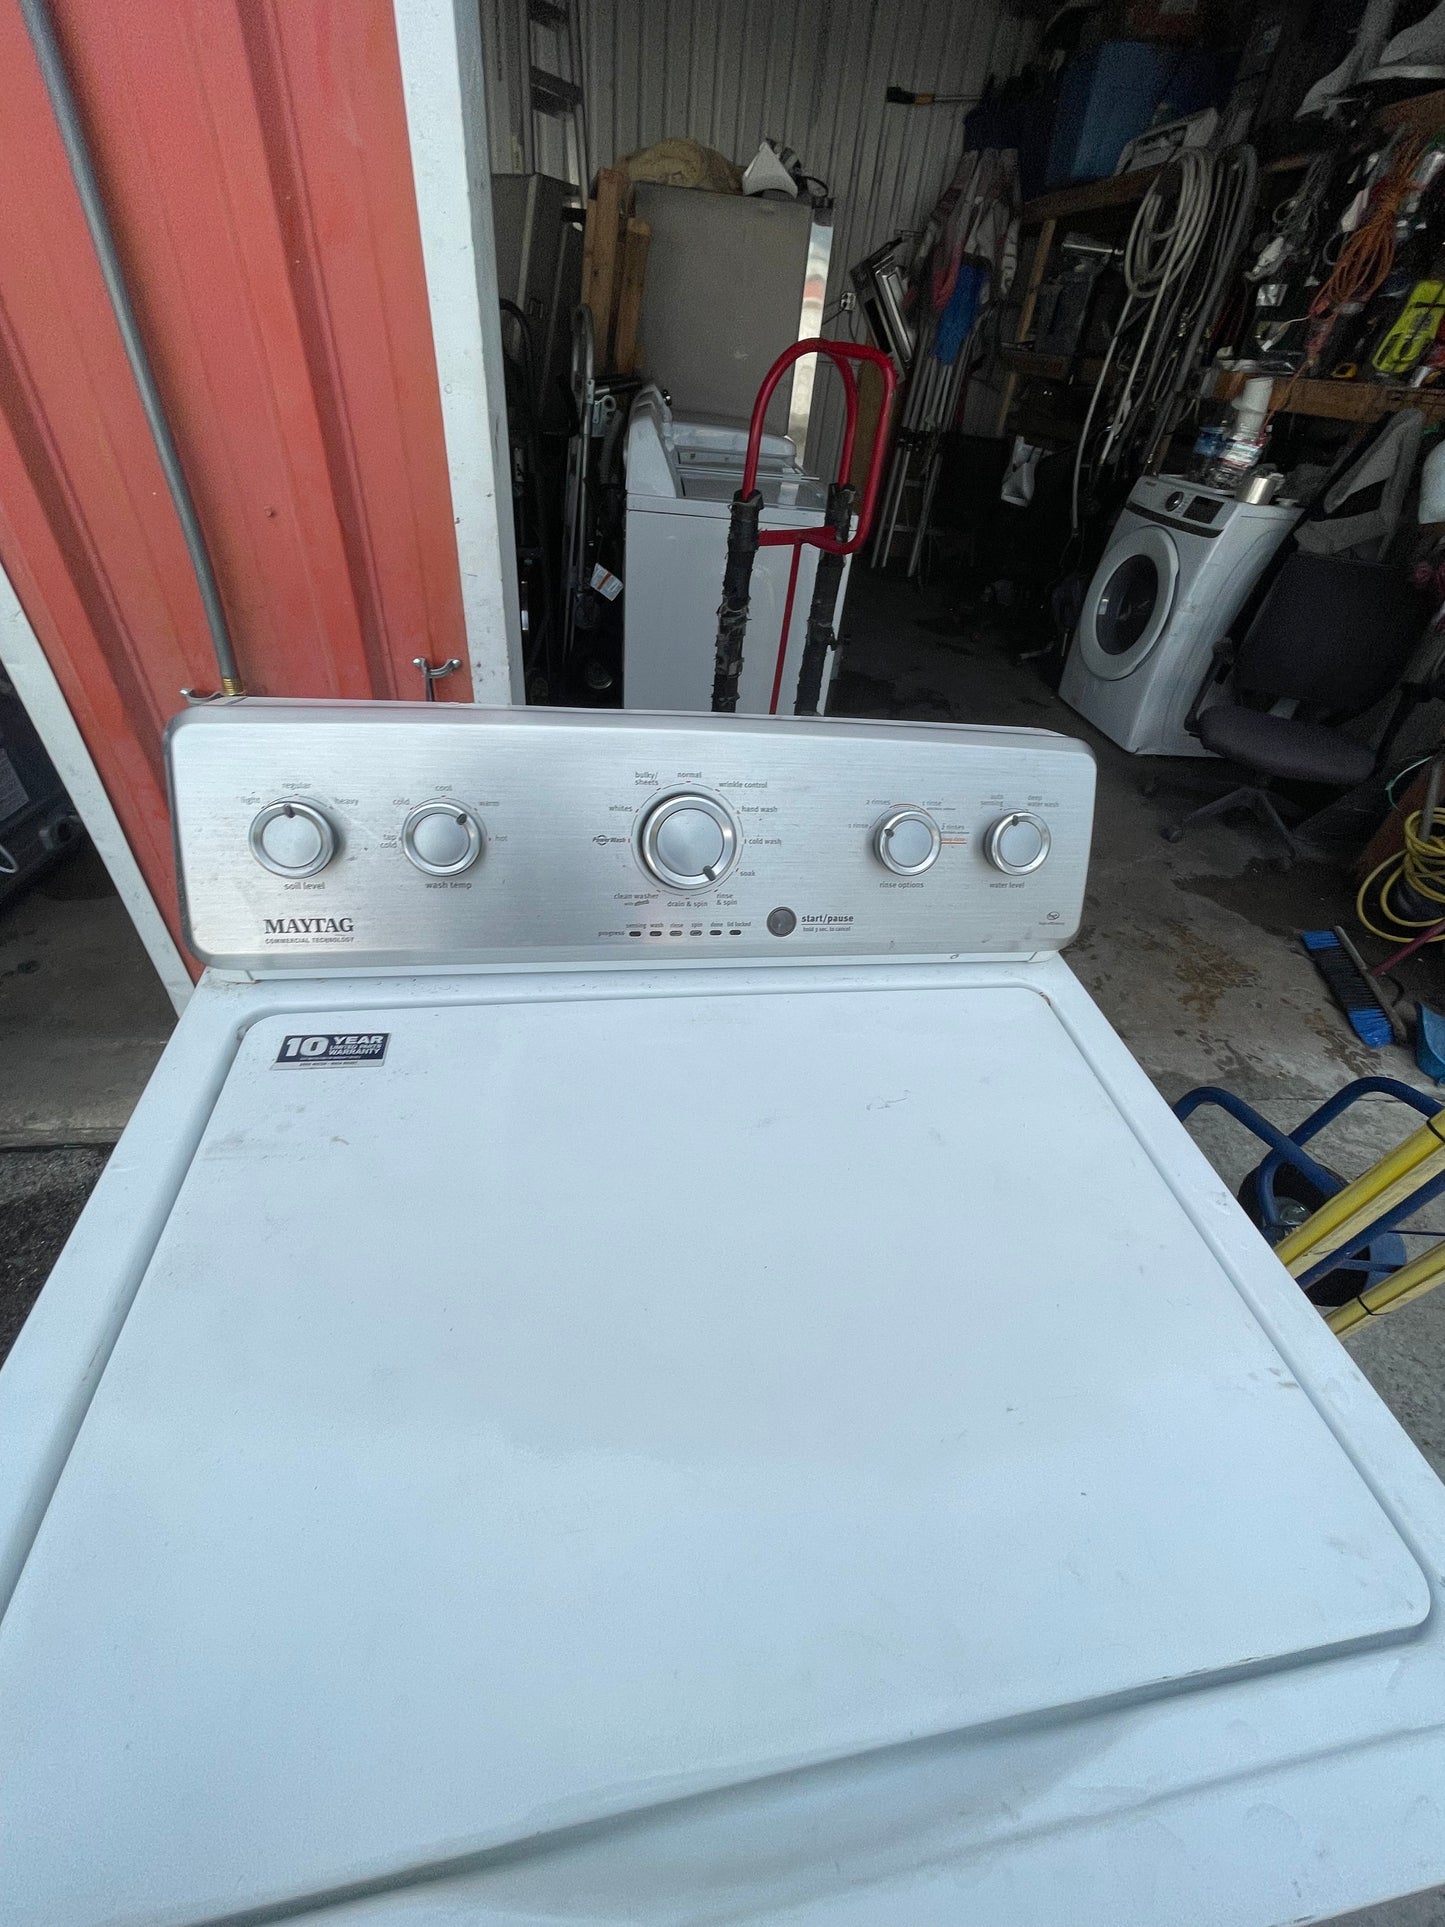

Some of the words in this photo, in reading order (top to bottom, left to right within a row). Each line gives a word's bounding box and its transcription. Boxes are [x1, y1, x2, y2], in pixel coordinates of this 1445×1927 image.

[677, 771, 702, 779] normal
[282, 781, 311, 790] regular
[435, 784, 453, 792] cool
[719, 781, 743, 789] wrinkle
[744, 781, 768, 789] control
[334, 797, 359, 806] heavy
[393, 797, 410, 806] cold
[609, 805, 633, 813] whites
[383, 833, 397, 842] tap
[495, 834, 508, 842] hot
[380, 841, 397, 849] cold
[765, 838, 782, 846] wash
[740, 869, 756, 877] soak
[284, 881, 301, 890] soil
[303, 881, 325, 890] level
[425, 881, 449, 889] wash
[450, 881, 472, 890] temp
[898, 881, 924, 889] options
[723, 899, 737, 907] spin
[801, 914, 854, 924] start/pause
[264, 918, 354, 934] MAYTAG
[312, 936, 354, 944] TECHNOLOGY
[286, 1037, 329, 1057] 10
[333, 1035, 383, 1045] YEAR
[328, 1048, 381, 1056] WARRANTY
